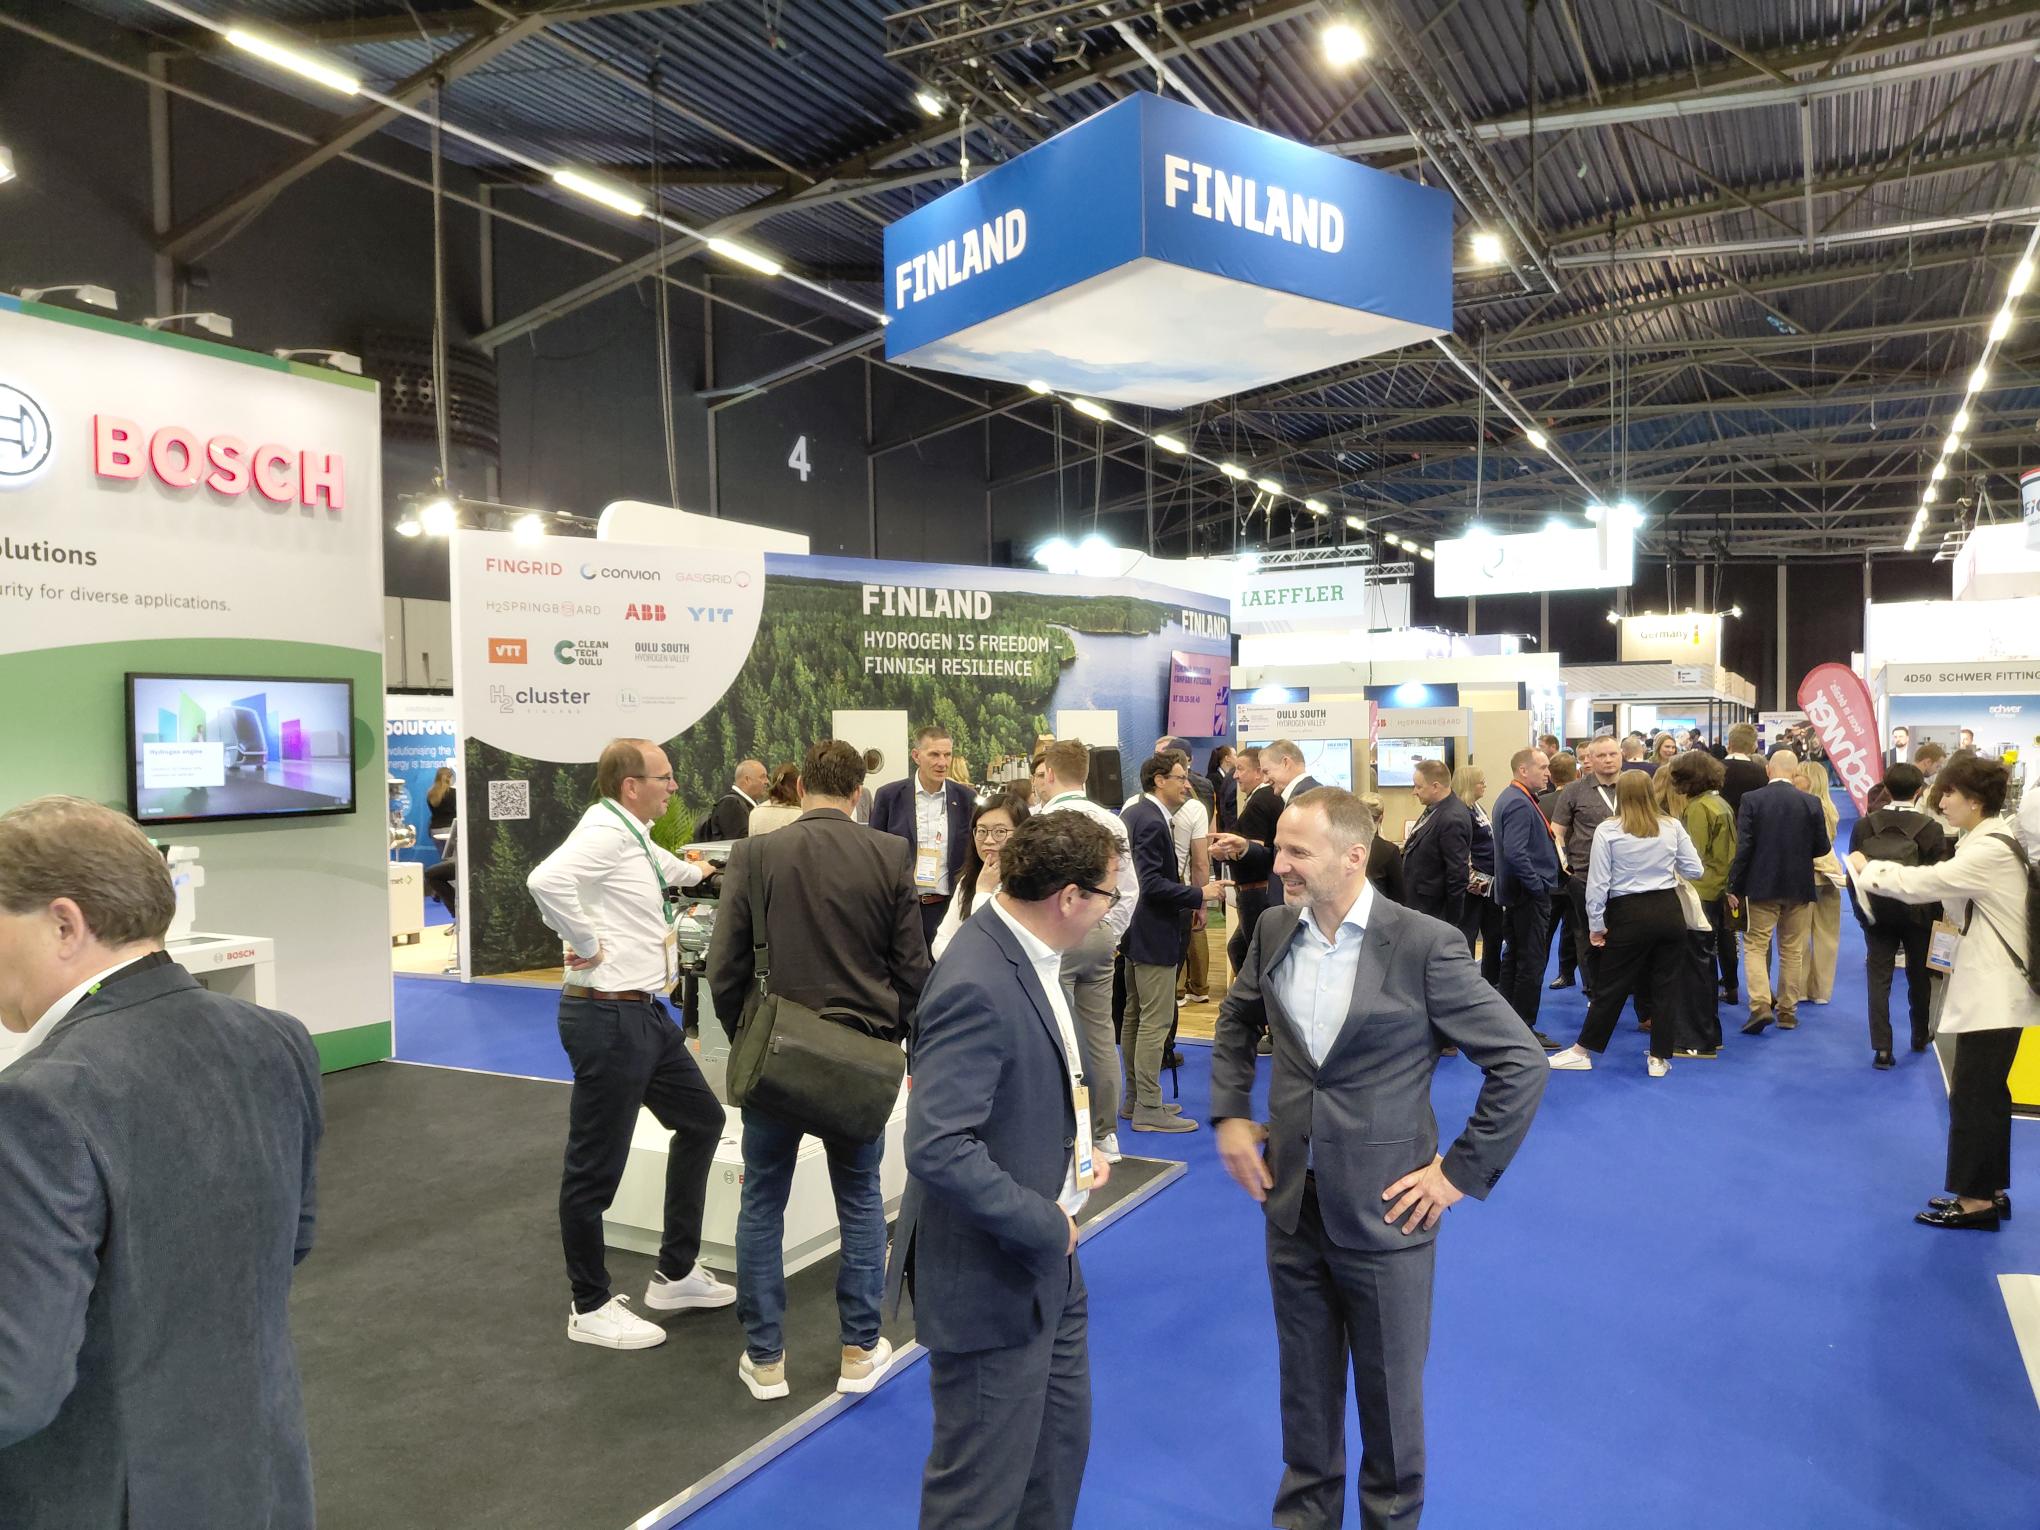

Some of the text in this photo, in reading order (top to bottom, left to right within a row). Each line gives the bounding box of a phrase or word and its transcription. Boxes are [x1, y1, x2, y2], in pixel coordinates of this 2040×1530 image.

[1163, 153, 1345, 254] FINLAND
[896, 208, 1027, 309] FINLAND
[94, 414, 344, 510] BOSCH
[788, 435, 811, 482] 4
[0, 537, 97, 566] lutions
[486, 558, 562, 576] FINGRID
[601, 568, 660, 581] convion
[675, 571, 732, 585] GASGRID
[40, 583, 64, 600] for
[70, 587, 129, 605] diverse
[134, 592, 231, 612] applications.
[862, 584, 992, 620] FINLAND
[625, 603, 666, 621] ABB
[687, 607, 734, 622] YIT
[1182, 609, 1228, 640] FINLAND
[578, 640, 609, 649] CLEAN
[635, 642, 690, 653] OULU SOUTH
[864, 631, 952, 650] HYDROGEN
[958, 634, 975, 651] IS
[980, 635, 1049, 653] FREEDOM
[495, 645, 522, 657] VTT
[575, 649, 598, 657] TECH
[635, 653, 690, 663] HYDROGEN VALLEY
[578, 658, 603, 666] OULU
[865, 657, 1032, 677] FINNISH RESILIENCE
[1904, 674, 1932, 682] 4D50
[1939, 672, 1992, 682] SCHWER
[516, 687, 590, 704] cluster
[1277, 710, 1298, 719] OULU
[1300, 709, 1326, 718] SOUTH
[226, 949, 255, 960] BOSCH
